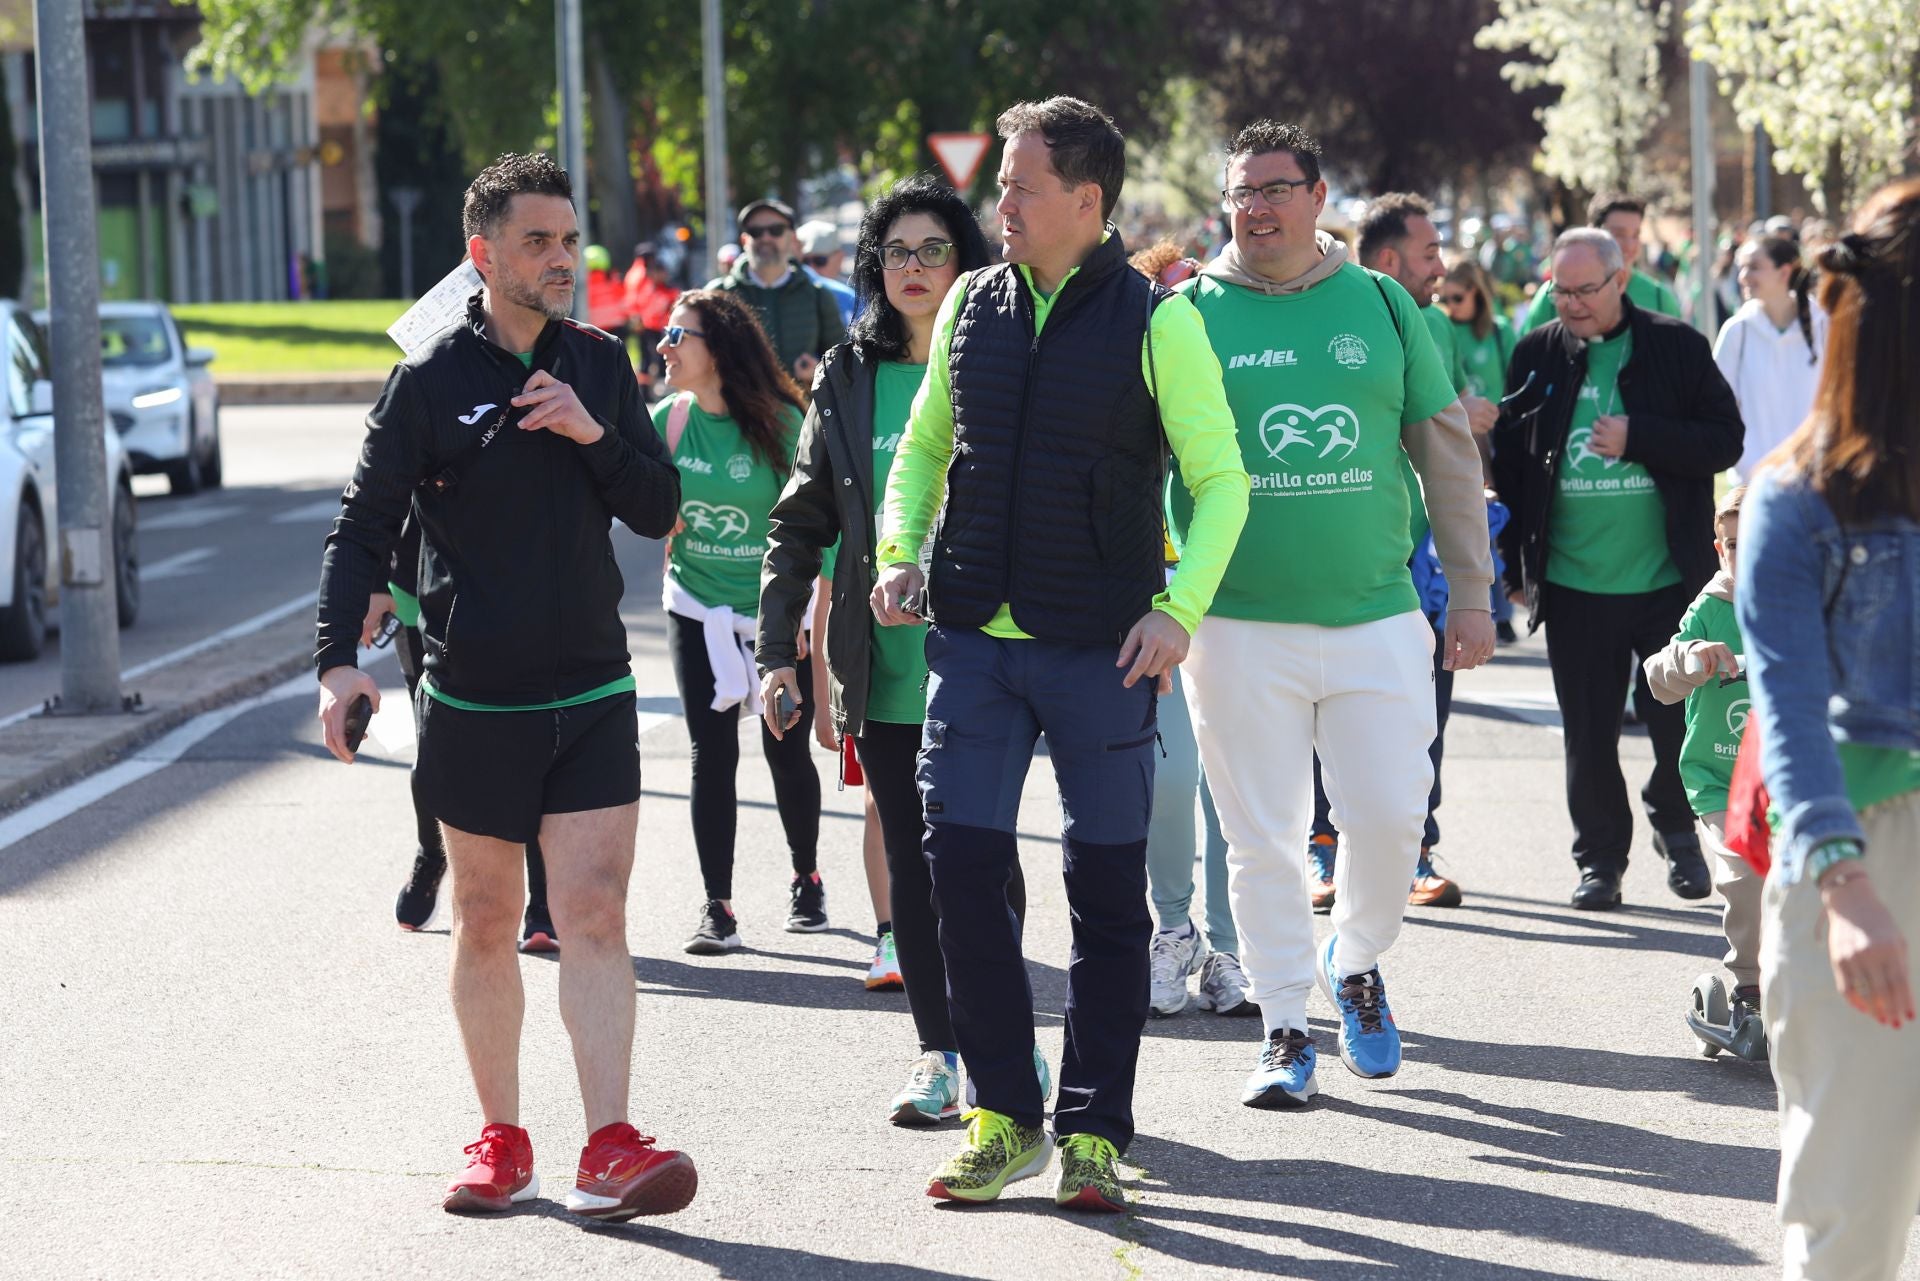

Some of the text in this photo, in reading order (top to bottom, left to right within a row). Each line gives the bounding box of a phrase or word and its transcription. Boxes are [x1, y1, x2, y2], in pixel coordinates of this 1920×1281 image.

[1228, 349, 1298, 369] INAEL
[1250, 467, 1373, 489] Brilla con ellos
[1560, 475, 1655, 492] Brilla con ellos
[733, 544, 764, 557] ellos
